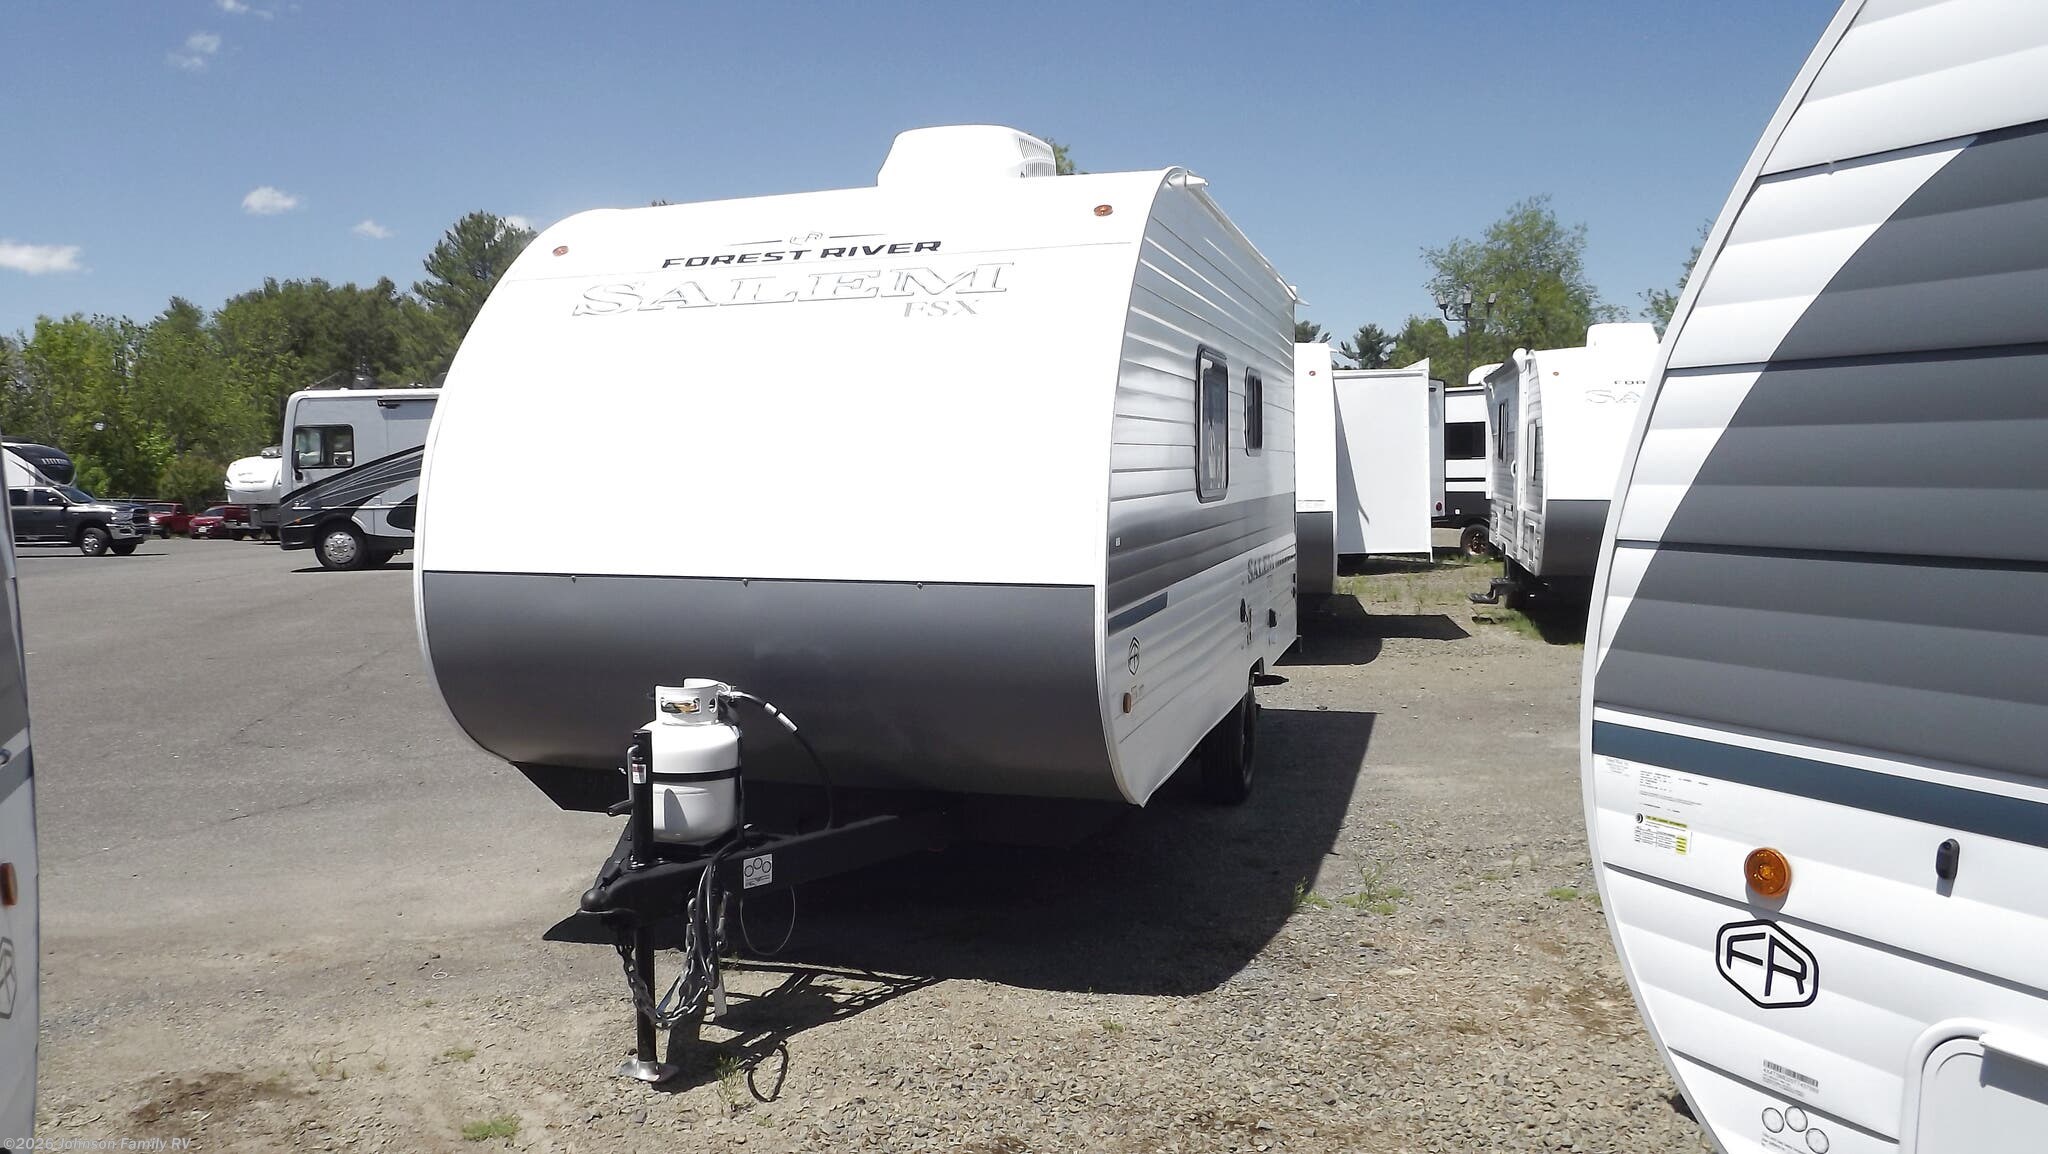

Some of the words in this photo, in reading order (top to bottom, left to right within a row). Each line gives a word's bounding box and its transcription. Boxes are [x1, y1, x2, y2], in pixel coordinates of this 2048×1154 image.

[661, 249, 812, 269] FOREST
[820, 240, 942, 260] RIVER
[572, 261, 1015, 318] SALEM
[1726, 932, 1807, 997] FR
